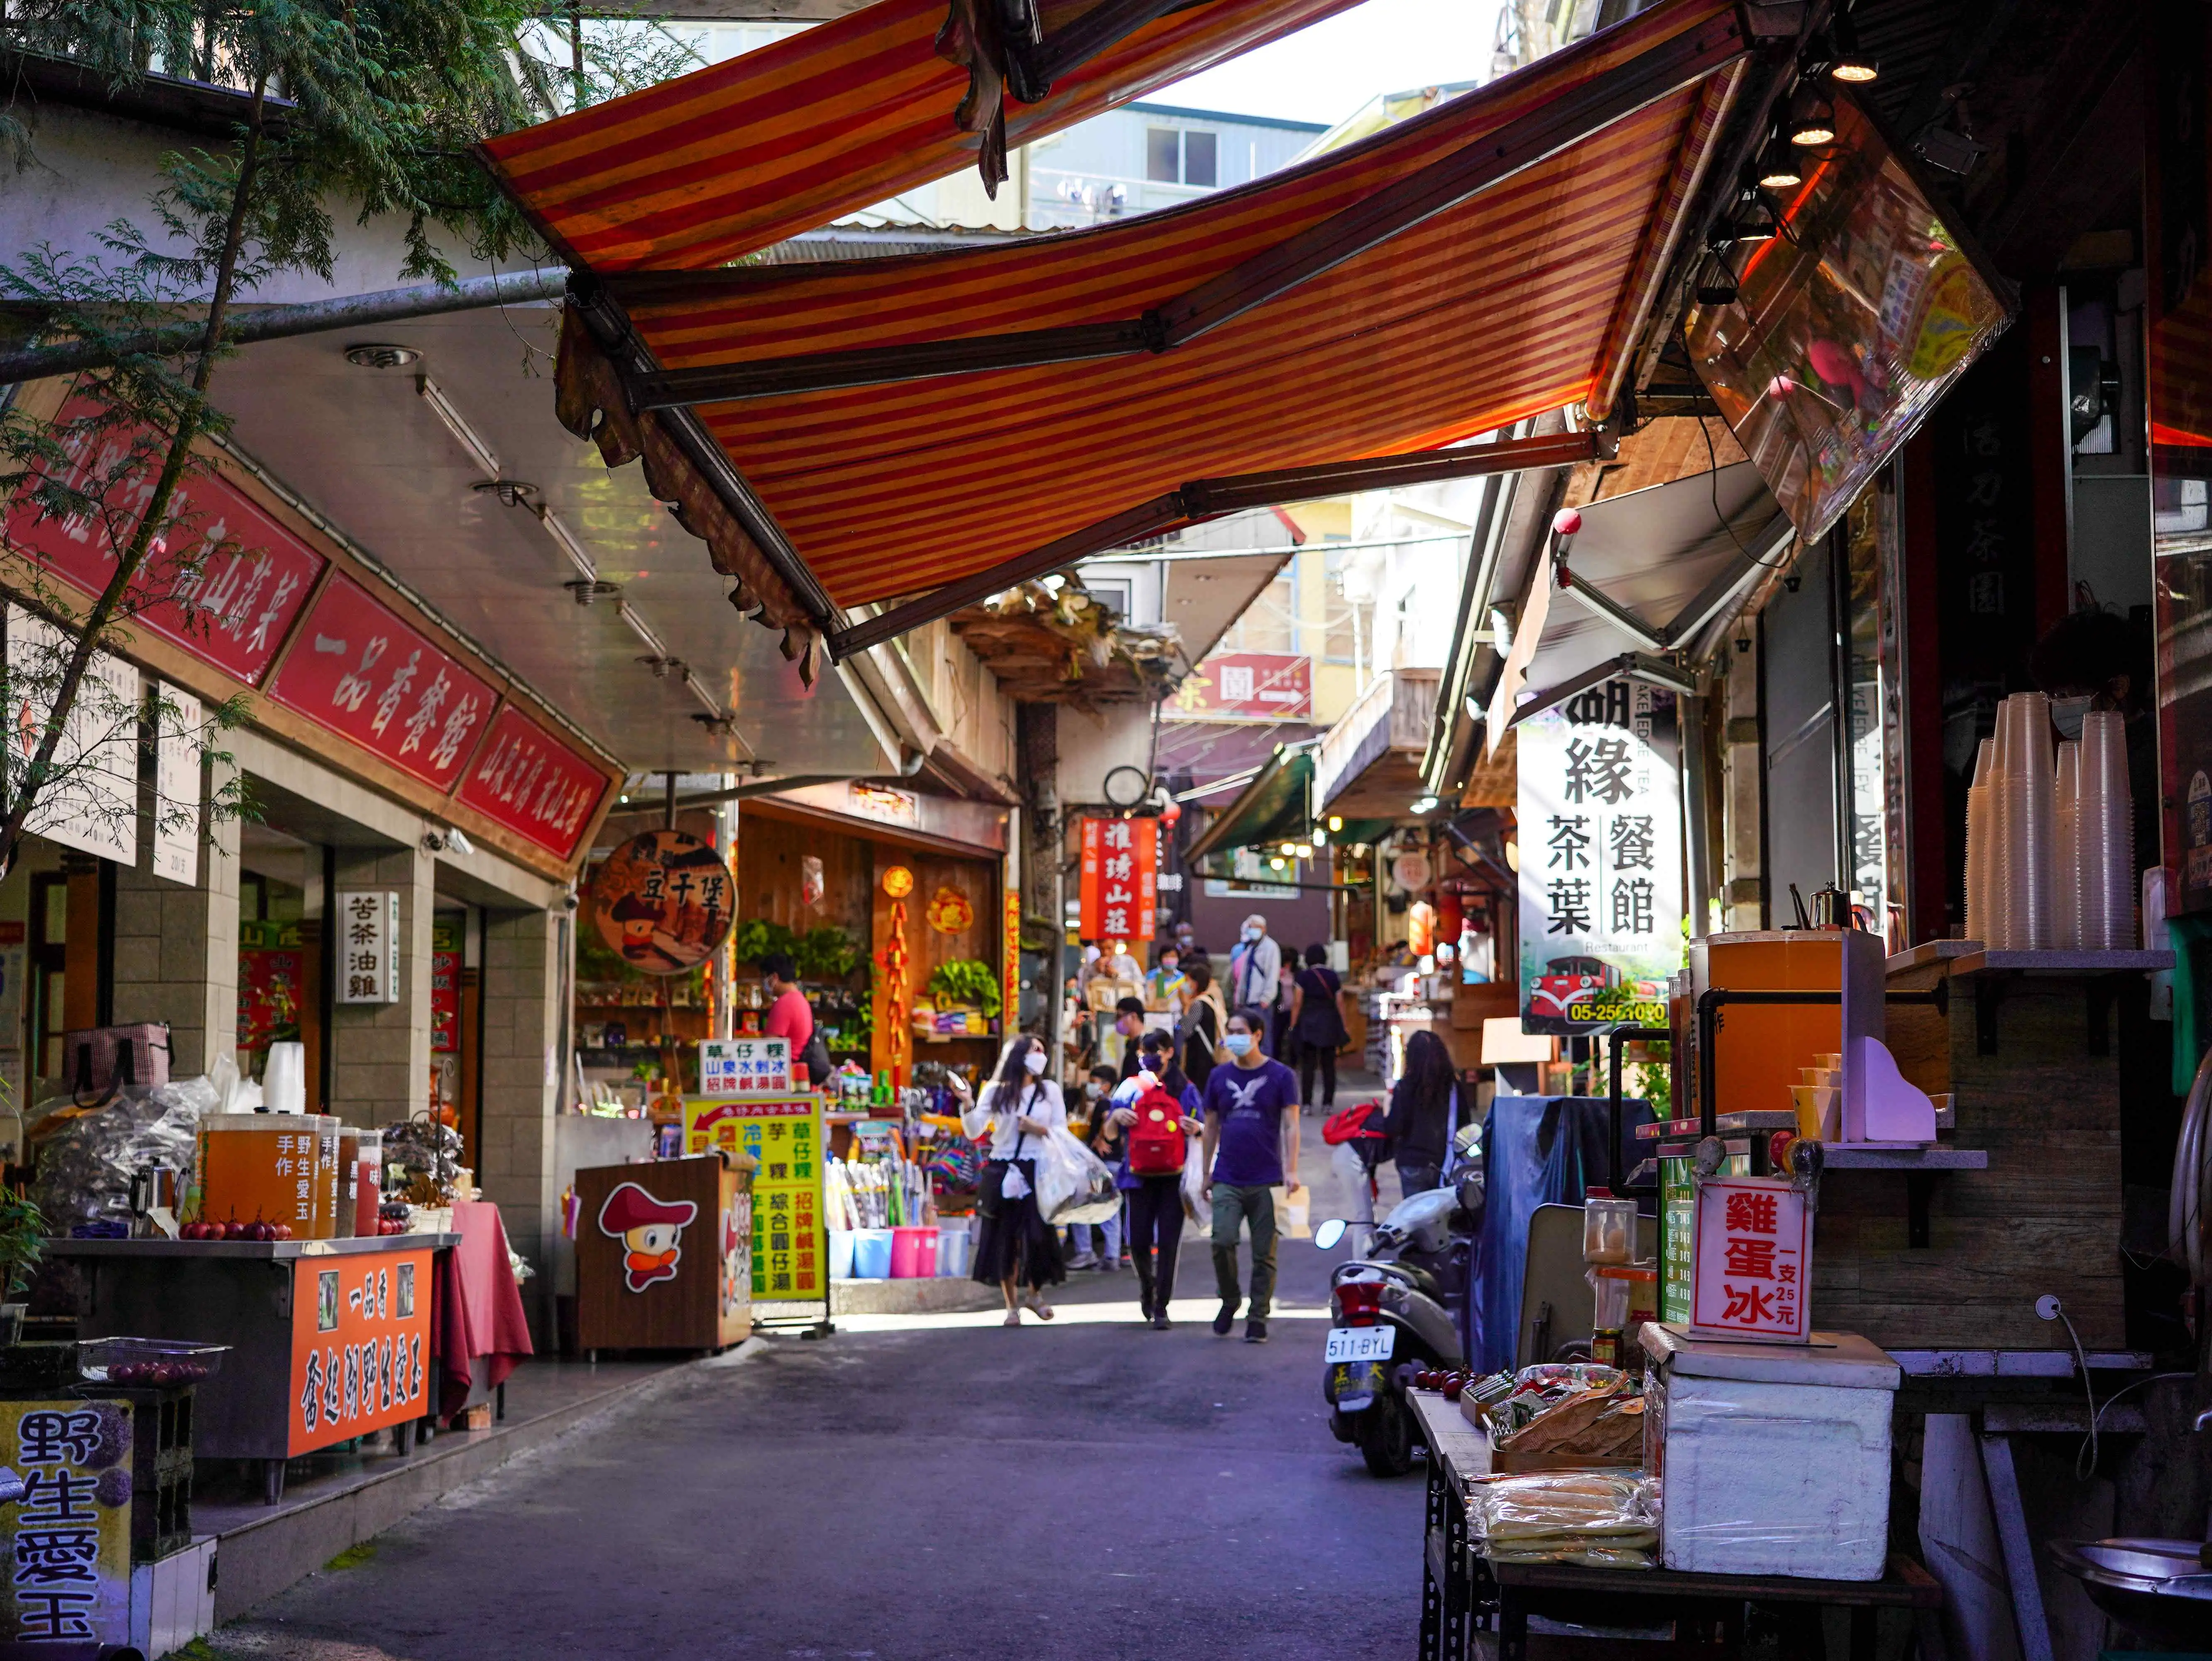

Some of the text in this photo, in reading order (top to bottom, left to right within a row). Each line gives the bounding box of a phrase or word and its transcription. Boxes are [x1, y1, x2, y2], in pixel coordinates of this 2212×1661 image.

[315, 634, 478, 770] 一品香餐館
[1637, 685, 1648, 711] AKE
[642, 871, 724, 909] 豆干堡
[1546, 814, 1591, 935] 茶葉
[1610, 814, 1654, 935] 餐館
[1586, 941, 1647, 953] Restaurant
[707, 1044, 784, 1058] 草仔粿
[276, 1135, 294, 1177] 手作
[295, 1135, 312, 1221] 野生愛玉
[793, 1122, 811, 1179] 草仔粿
[1721, 1192, 1778, 1324] 雞蛋冰
[349, 1267, 387, 1320] 一品香
[12, 1409, 102, 1643] 野生愛玉
